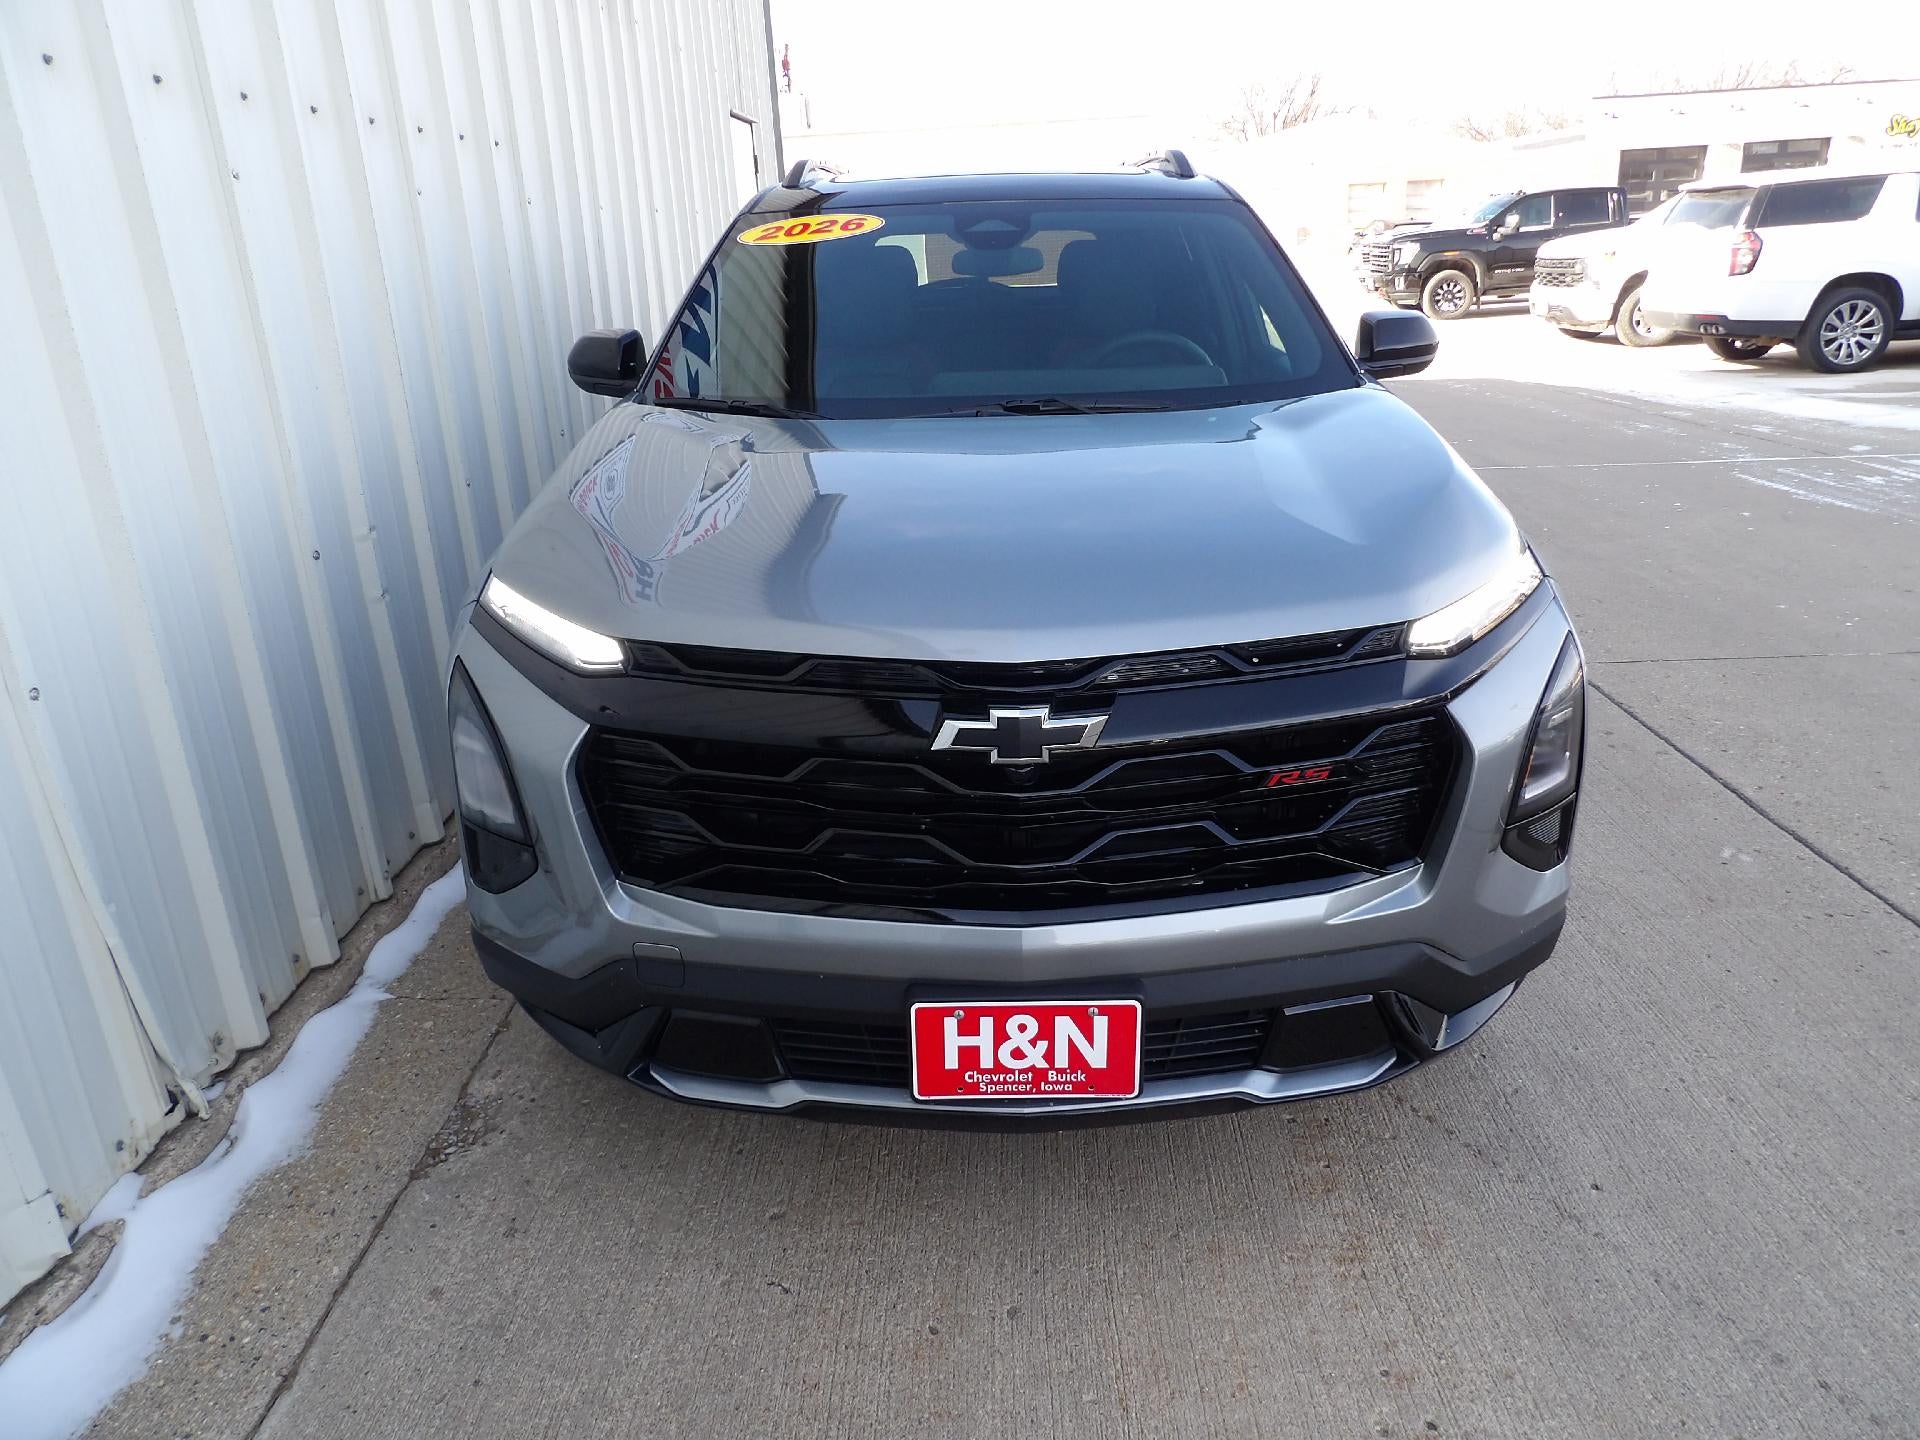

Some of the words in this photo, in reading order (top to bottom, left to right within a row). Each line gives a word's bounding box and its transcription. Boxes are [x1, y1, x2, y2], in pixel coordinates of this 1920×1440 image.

[752, 217, 868, 243] 2026
[1264, 764, 1334, 788] RS
[943, 1014, 1109, 1070] H&N
[964, 1070, 1033, 1083] Chevrolet
[1048, 1070, 1086, 1083] Buick
[979, 1082, 1036, 1093] Spencer,
[1041, 1081, 1073, 1092] Iowa
